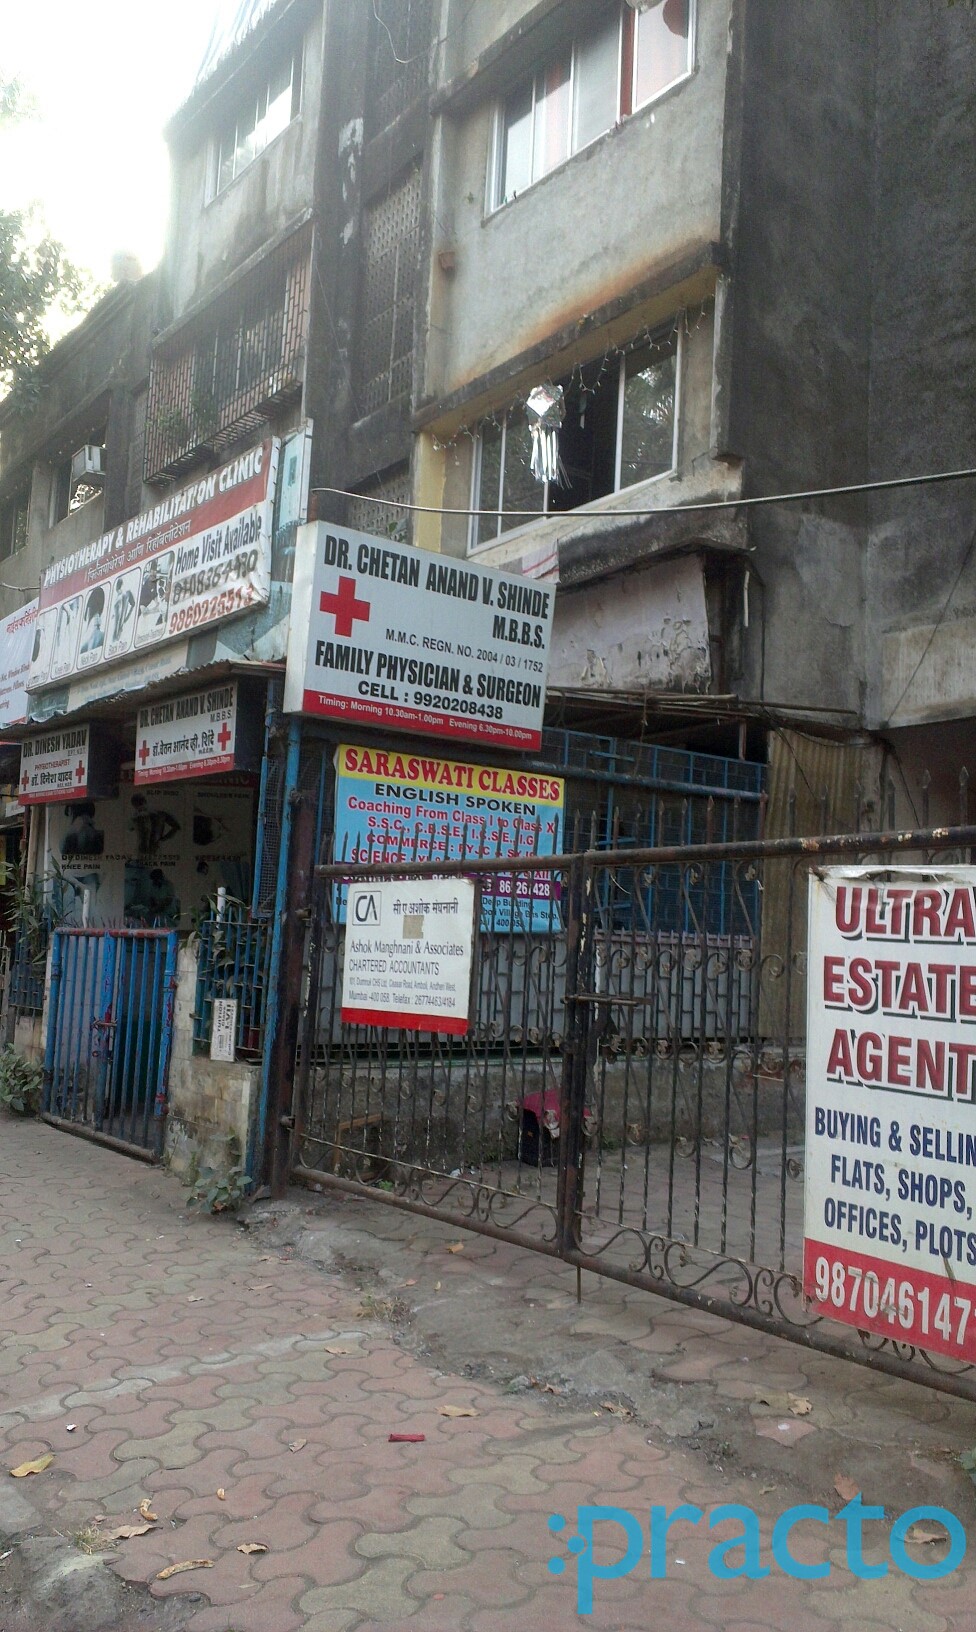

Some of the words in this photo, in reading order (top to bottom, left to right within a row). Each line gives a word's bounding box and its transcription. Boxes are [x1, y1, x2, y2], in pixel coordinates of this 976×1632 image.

[44, 530, 116, 588] PHYSIOTHERAPY
[115, 526, 124, 548] &
[126, 475, 217, 543] REHABILITATION
[218, 447, 264, 492] CLINIC
[175, 546, 200, 576] Home
[202, 529, 222, 564] Visit
[222, 511, 262, 556] Available
[324, 534, 353, 571] DR.
[356, 543, 421, 588] CHETAN
[425, 562, 479, 602] ANAND
[482, 576, 494, 607] V.
[497, 581, 551, 620] SHINDE
[386, 628, 420, 647] M.M.C.
[422, 636, 455, 655] REGN.
[456, 644, 474, 659] NO.
[477, 648, 498, 665] 2004
[505, 655, 517, 668] 03
[524, 658, 544, 674] 1752
[492, 614, 546, 650] M.B.B.S.
[315, 640, 374, 677] FAMILY
[376, 652, 460, 694] PHYSICIAN
[462, 674, 474, 696] &
[477, 673, 542, 709] SURGEON
[151, 703, 175, 726] CHETAN
[176, 696, 199, 721] ANAND
[206, 686, 234, 713] SHINDE
[318, 694, 349, 710] Timing:
[350, 700, 383, 717] Morning
[384, 706, 445, 727] 10.30am-1.00pm
[449, 719, 478, 733] Evening
[358, 680, 400, 702] CELL
[413, 691, 504, 720] 9920208438
[23, 742, 34, 758] DR.
[35, 735, 61, 755] DINESH
[61, 729, 87, 750] YADAV
[344, 748, 474, 789] SARASWATI
[478, 769, 561, 802] CLASSES
[347, 796, 411, 819] Coaching
[415, 805, 449, 821] From
[452, 809, 486, 826] Class
[489, 815, 493, 826] I
[374, 783, 460, 807] ENGLISH
[465, 796, 536, 816] SPOKEN
[367, 833, 446, 851] COMMERCE
[409, 898, 430, 915] अशोक
[835, 886, 976, 942] ULTRA
[349, 958, 387, 973] CHARTERED
[389, 960, 440, 976] ACCOUNTANTS
[350, 941, 372, 954] Ashok
[375, 940, 414, 958] Manghnani
[415, 942, 420, 954] &
[423, 941, 464, 957] Associates
[393, 993, 411, 1004] Telefax
[823, 955, 976, 1018] ESTATE
[826, 1028, 976, 1096] AGENT
[814, 1106, 881, 1148] BUYING
[888, 1120, 902, 1153] &
[831, 1154, 891, 1202] FLATS,
[898, 1168, 973, 1221] SHOPS,
[824, 1197, 908, 1253] OFFICES,
